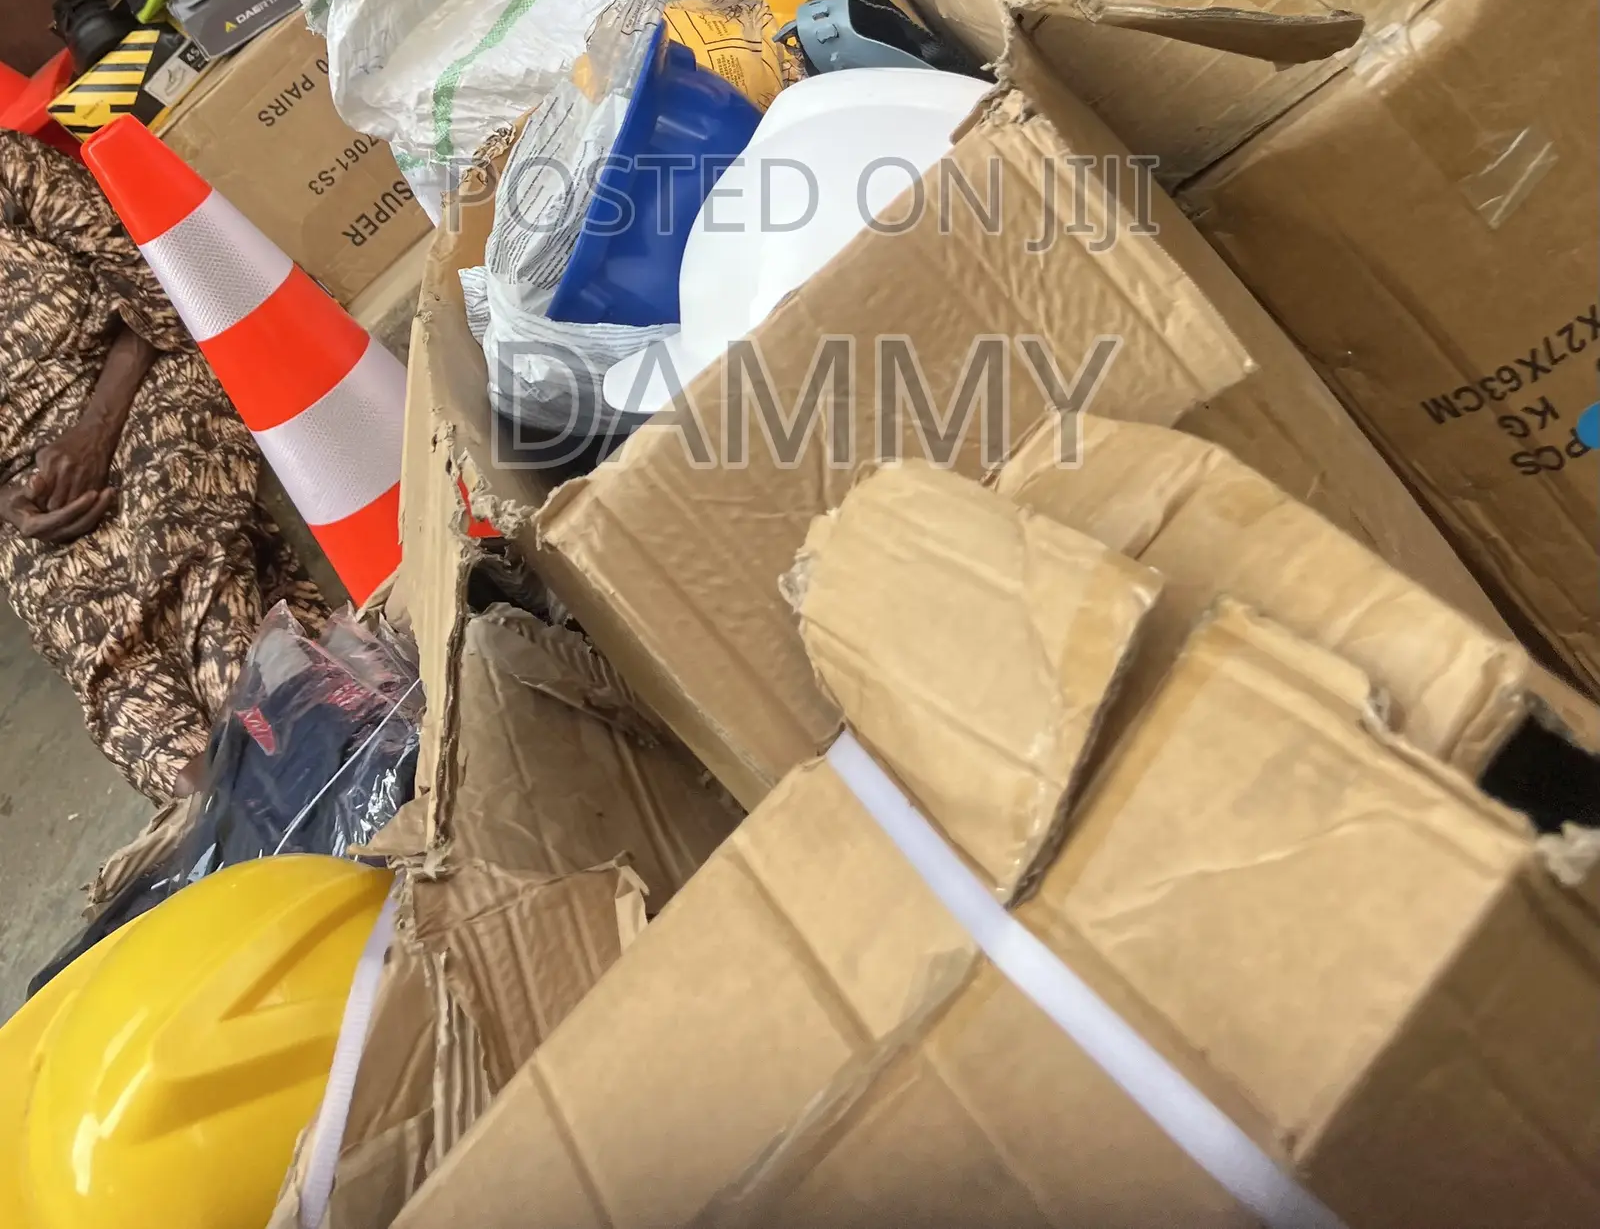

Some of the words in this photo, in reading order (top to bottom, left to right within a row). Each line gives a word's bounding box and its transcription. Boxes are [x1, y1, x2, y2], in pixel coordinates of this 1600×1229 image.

[257, 73, 316, 127] PAIRS
[308, 134, 379, 196] 7061-S3
[341, 180, 415, 247] SUPER
[1497, 396, 1560, 438] KG
[1510, 427, 1592, 475] PCS
